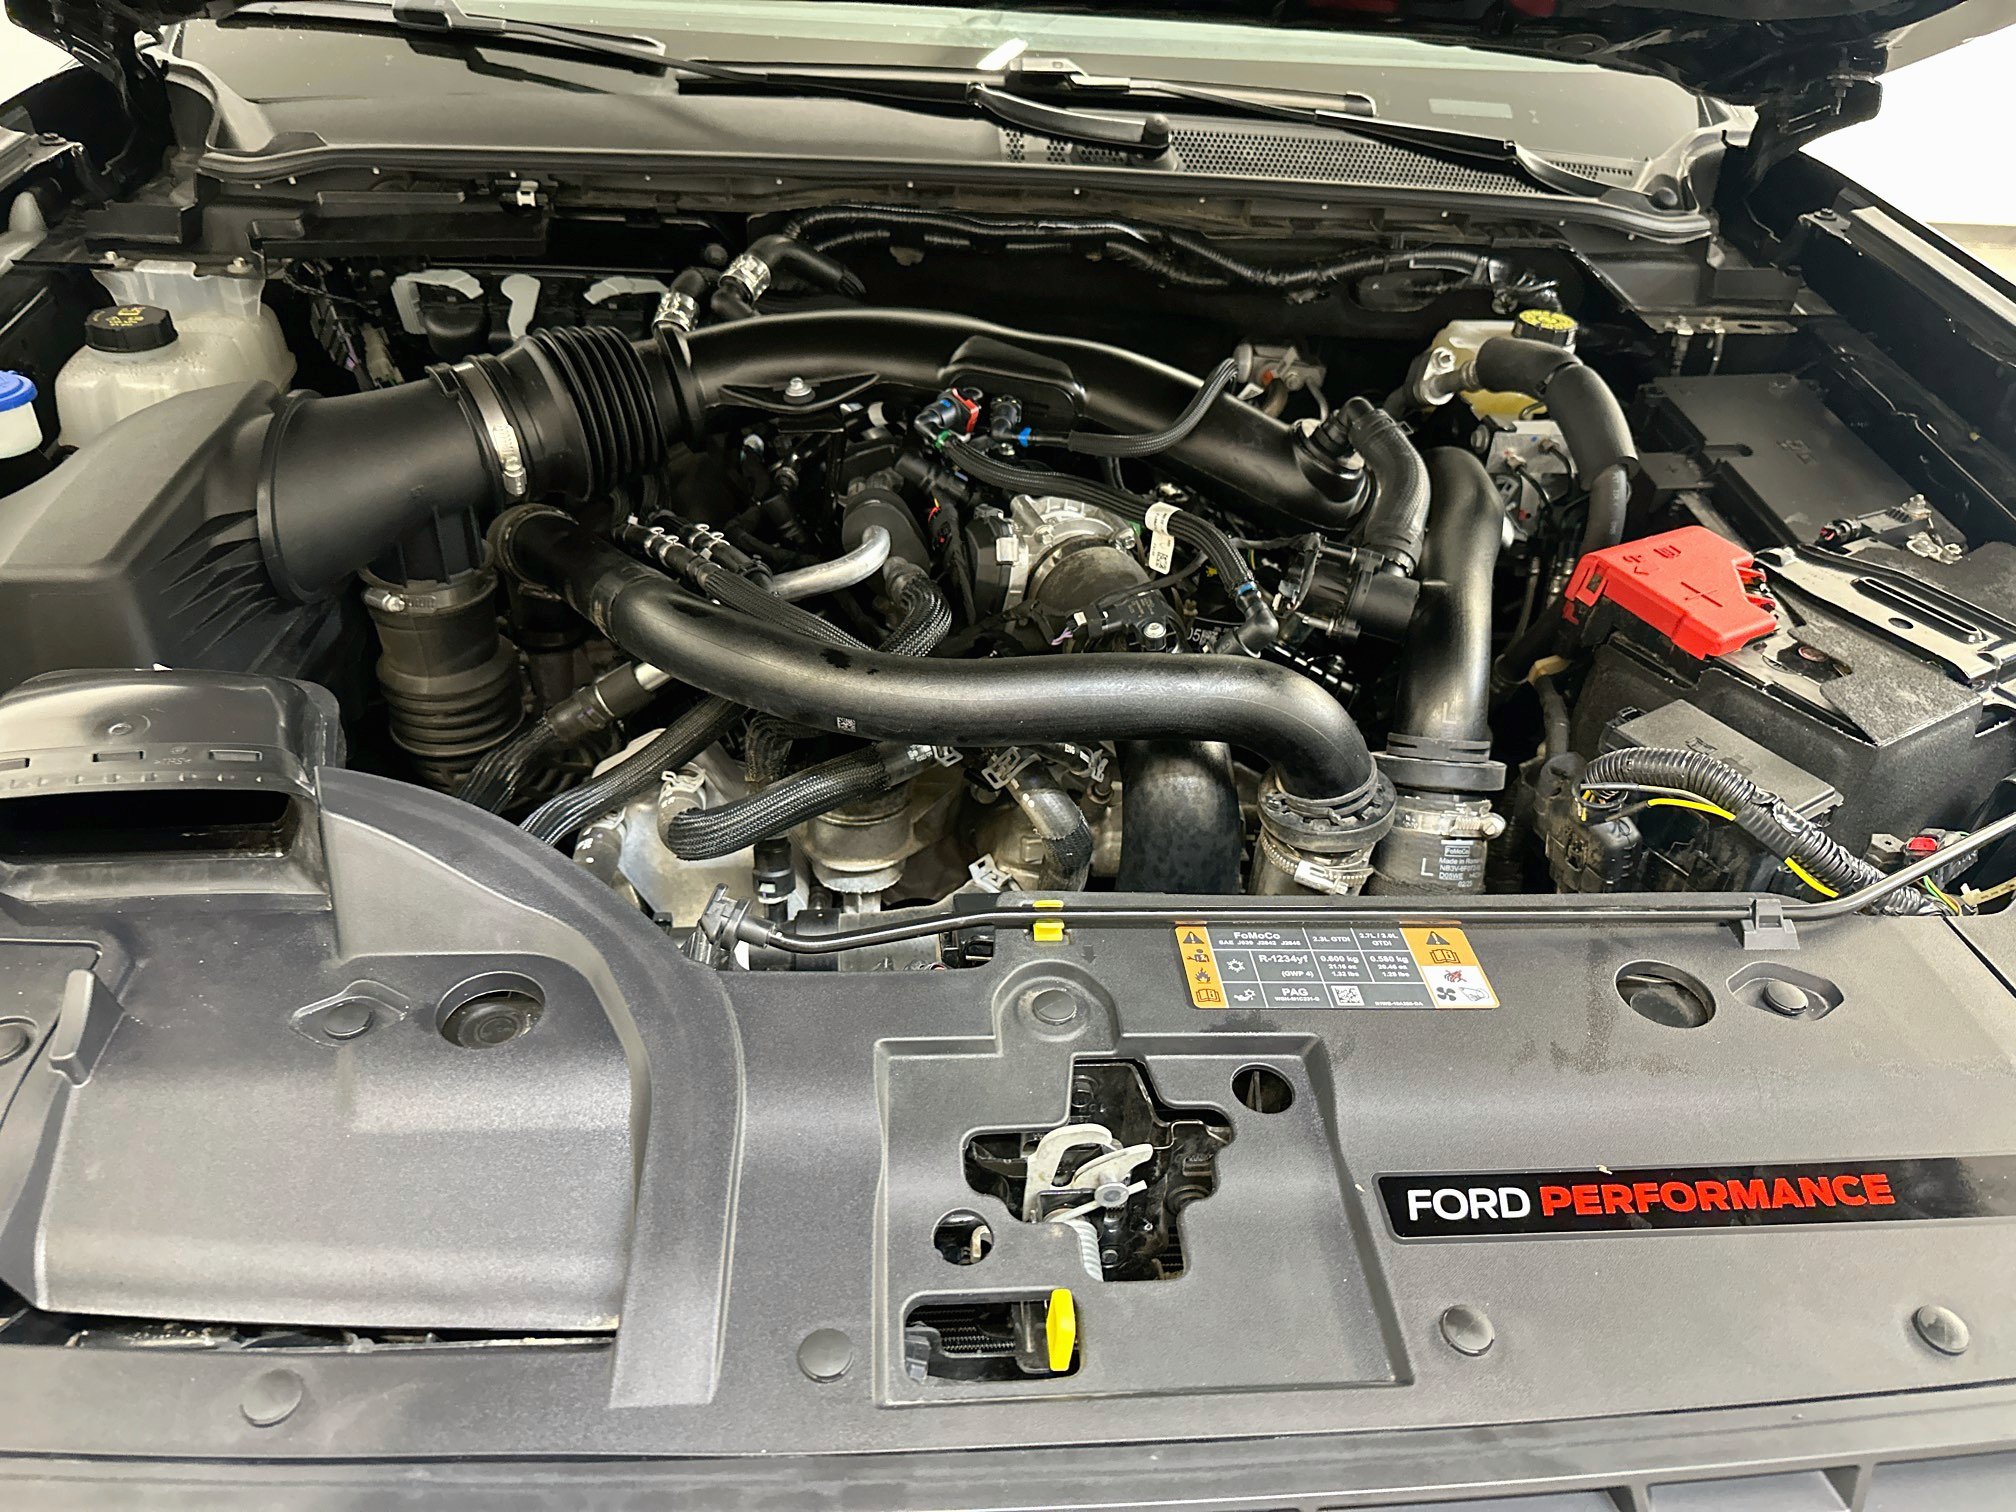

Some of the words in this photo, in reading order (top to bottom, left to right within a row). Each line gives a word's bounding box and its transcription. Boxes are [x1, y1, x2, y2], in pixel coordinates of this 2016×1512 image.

[1420, 858, 1434, 877] L
[1233, 931, 1281, 940] FoMoCo
[1258, 954, 1308, 965] R-1234yf
[1346, 955, 1360, 964] kg
[1395, 955, 1409, 964] kg
[1281, 987, 1309, 997] PAG
[1406, 1186, 1531, 1221] FORD
[1539, 1173, 1897, 1217] PERFORMANCE
